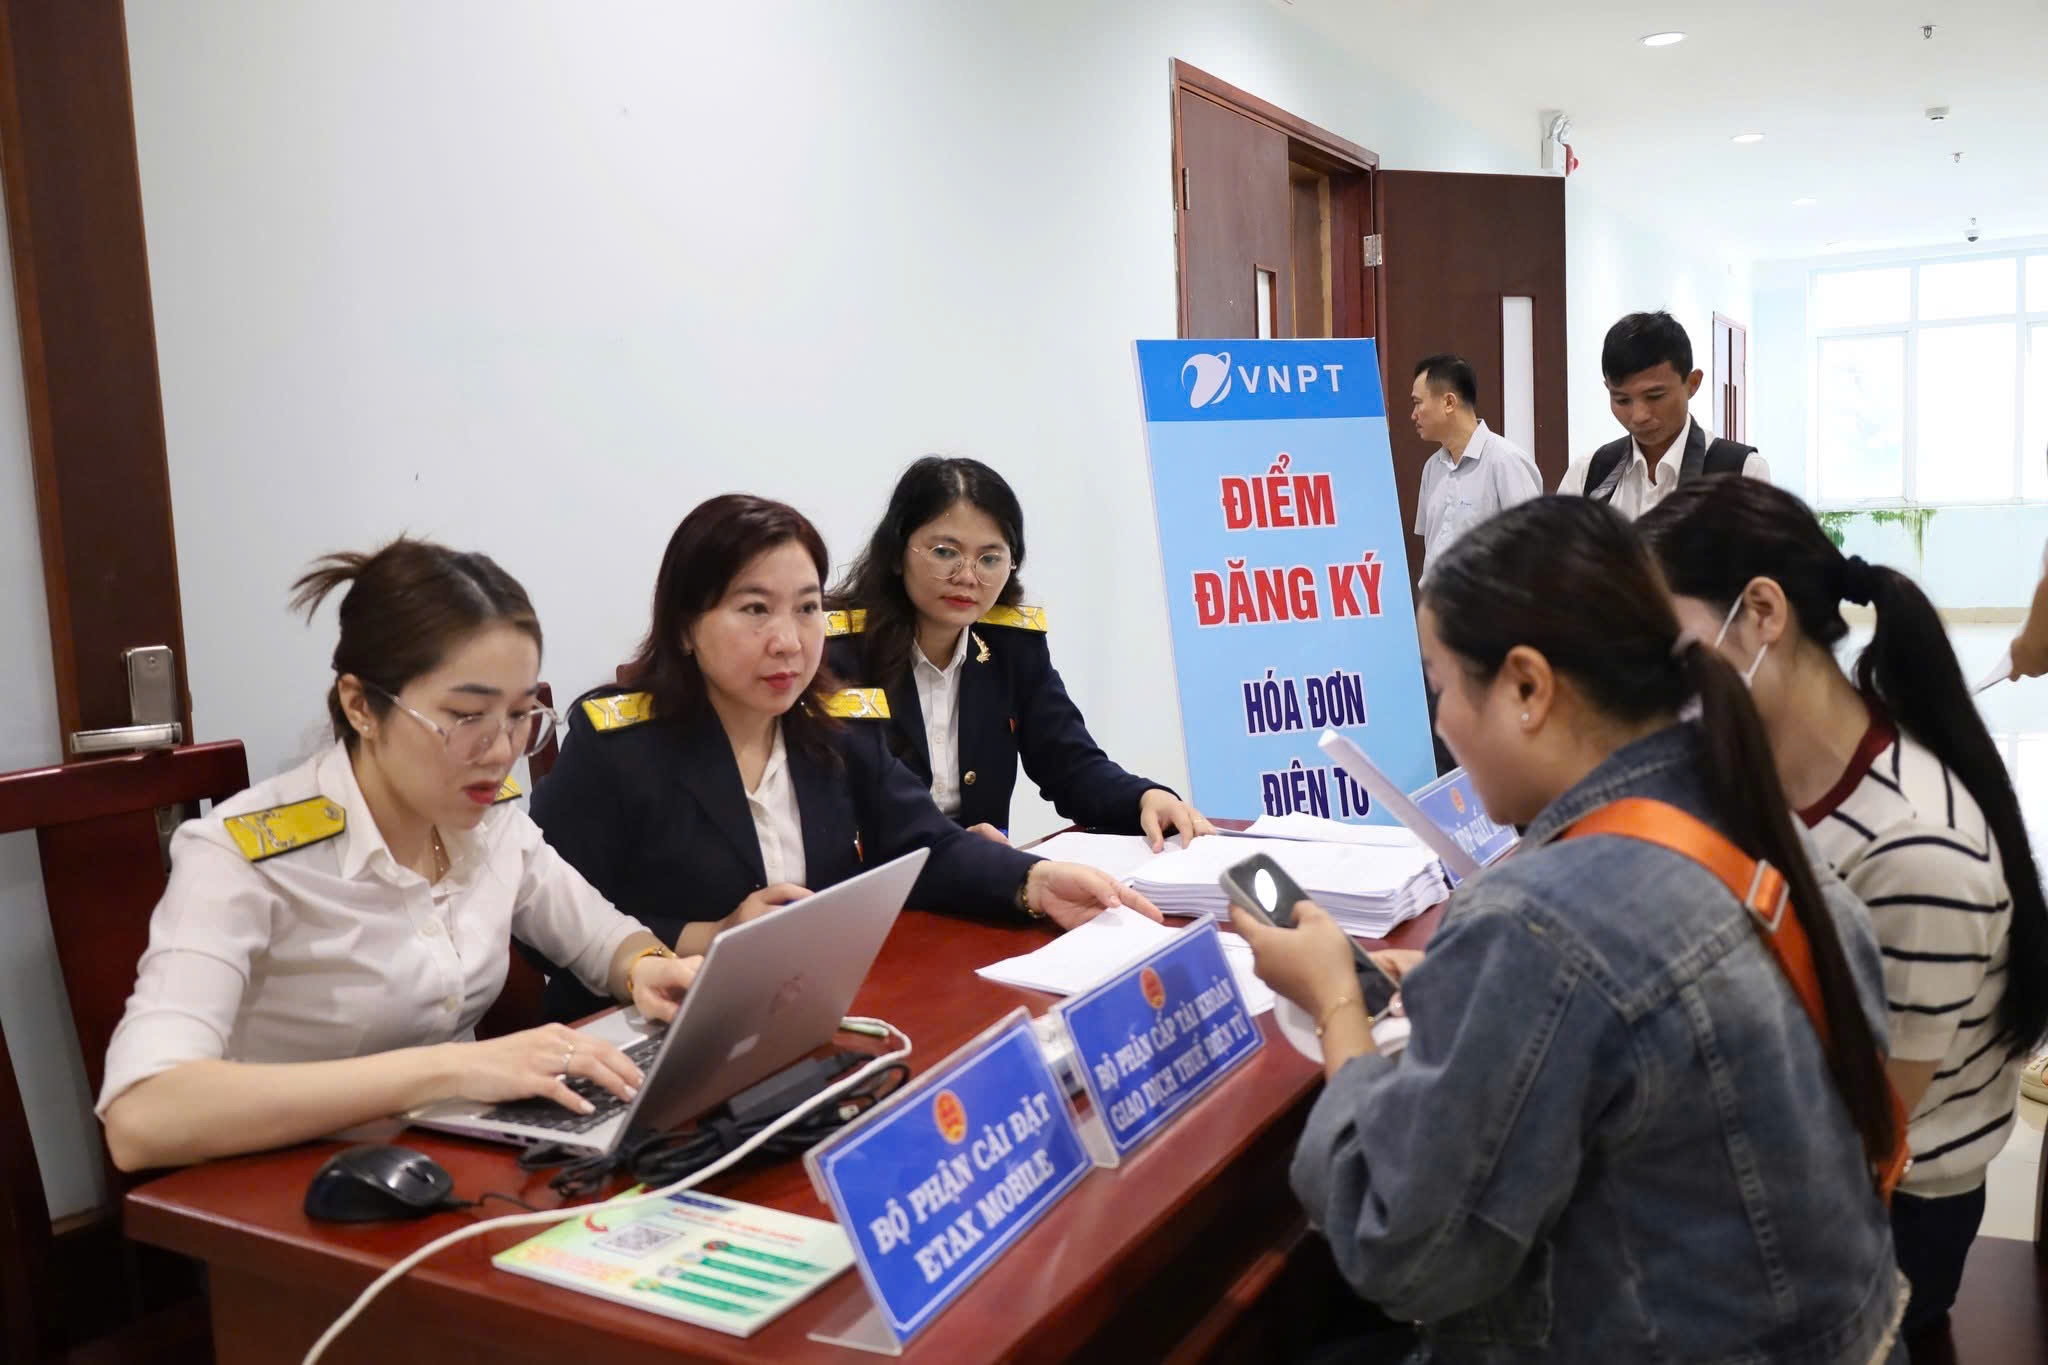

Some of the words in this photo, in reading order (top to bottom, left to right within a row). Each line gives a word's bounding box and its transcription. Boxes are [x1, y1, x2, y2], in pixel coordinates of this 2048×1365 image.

[1237, 363, 1345, 395] VNPT
[1220, 453, 1336, 530] ĐIỂM
[1193, 559, 1316, 627] ĐĂNG
[1329, 552, 1383, 617] KÝ
[1243, 669, 1301, 733] HÓA
[1308, 671, 1365, 727] ĐƠN
[1094, 1053, 1119, 1091] BỘ
[1115, 1033, 1154, 1077] PHẬN
[1151, 1011, 1178, 1052] CẤP
[1174, 1000, 1199, 1034] TÀI
[1110, 1089, 1146, 1131] GIAO
[1141, 1069, 1180, 1110] DỊCH
[1172, 1033, 1208, 1083] THUẾ
[869, 1197, 911, 1254] BỘ
[907, 1153, 974, 1224] PHẬN
[972, 1123, 1013, 1171] CÀI
[1008, 1091, 1051, 1143] ĐẶT
[913, 1209, 985, 1284] ETAX
[976, 1149, 1055, 1230] MOBILE
